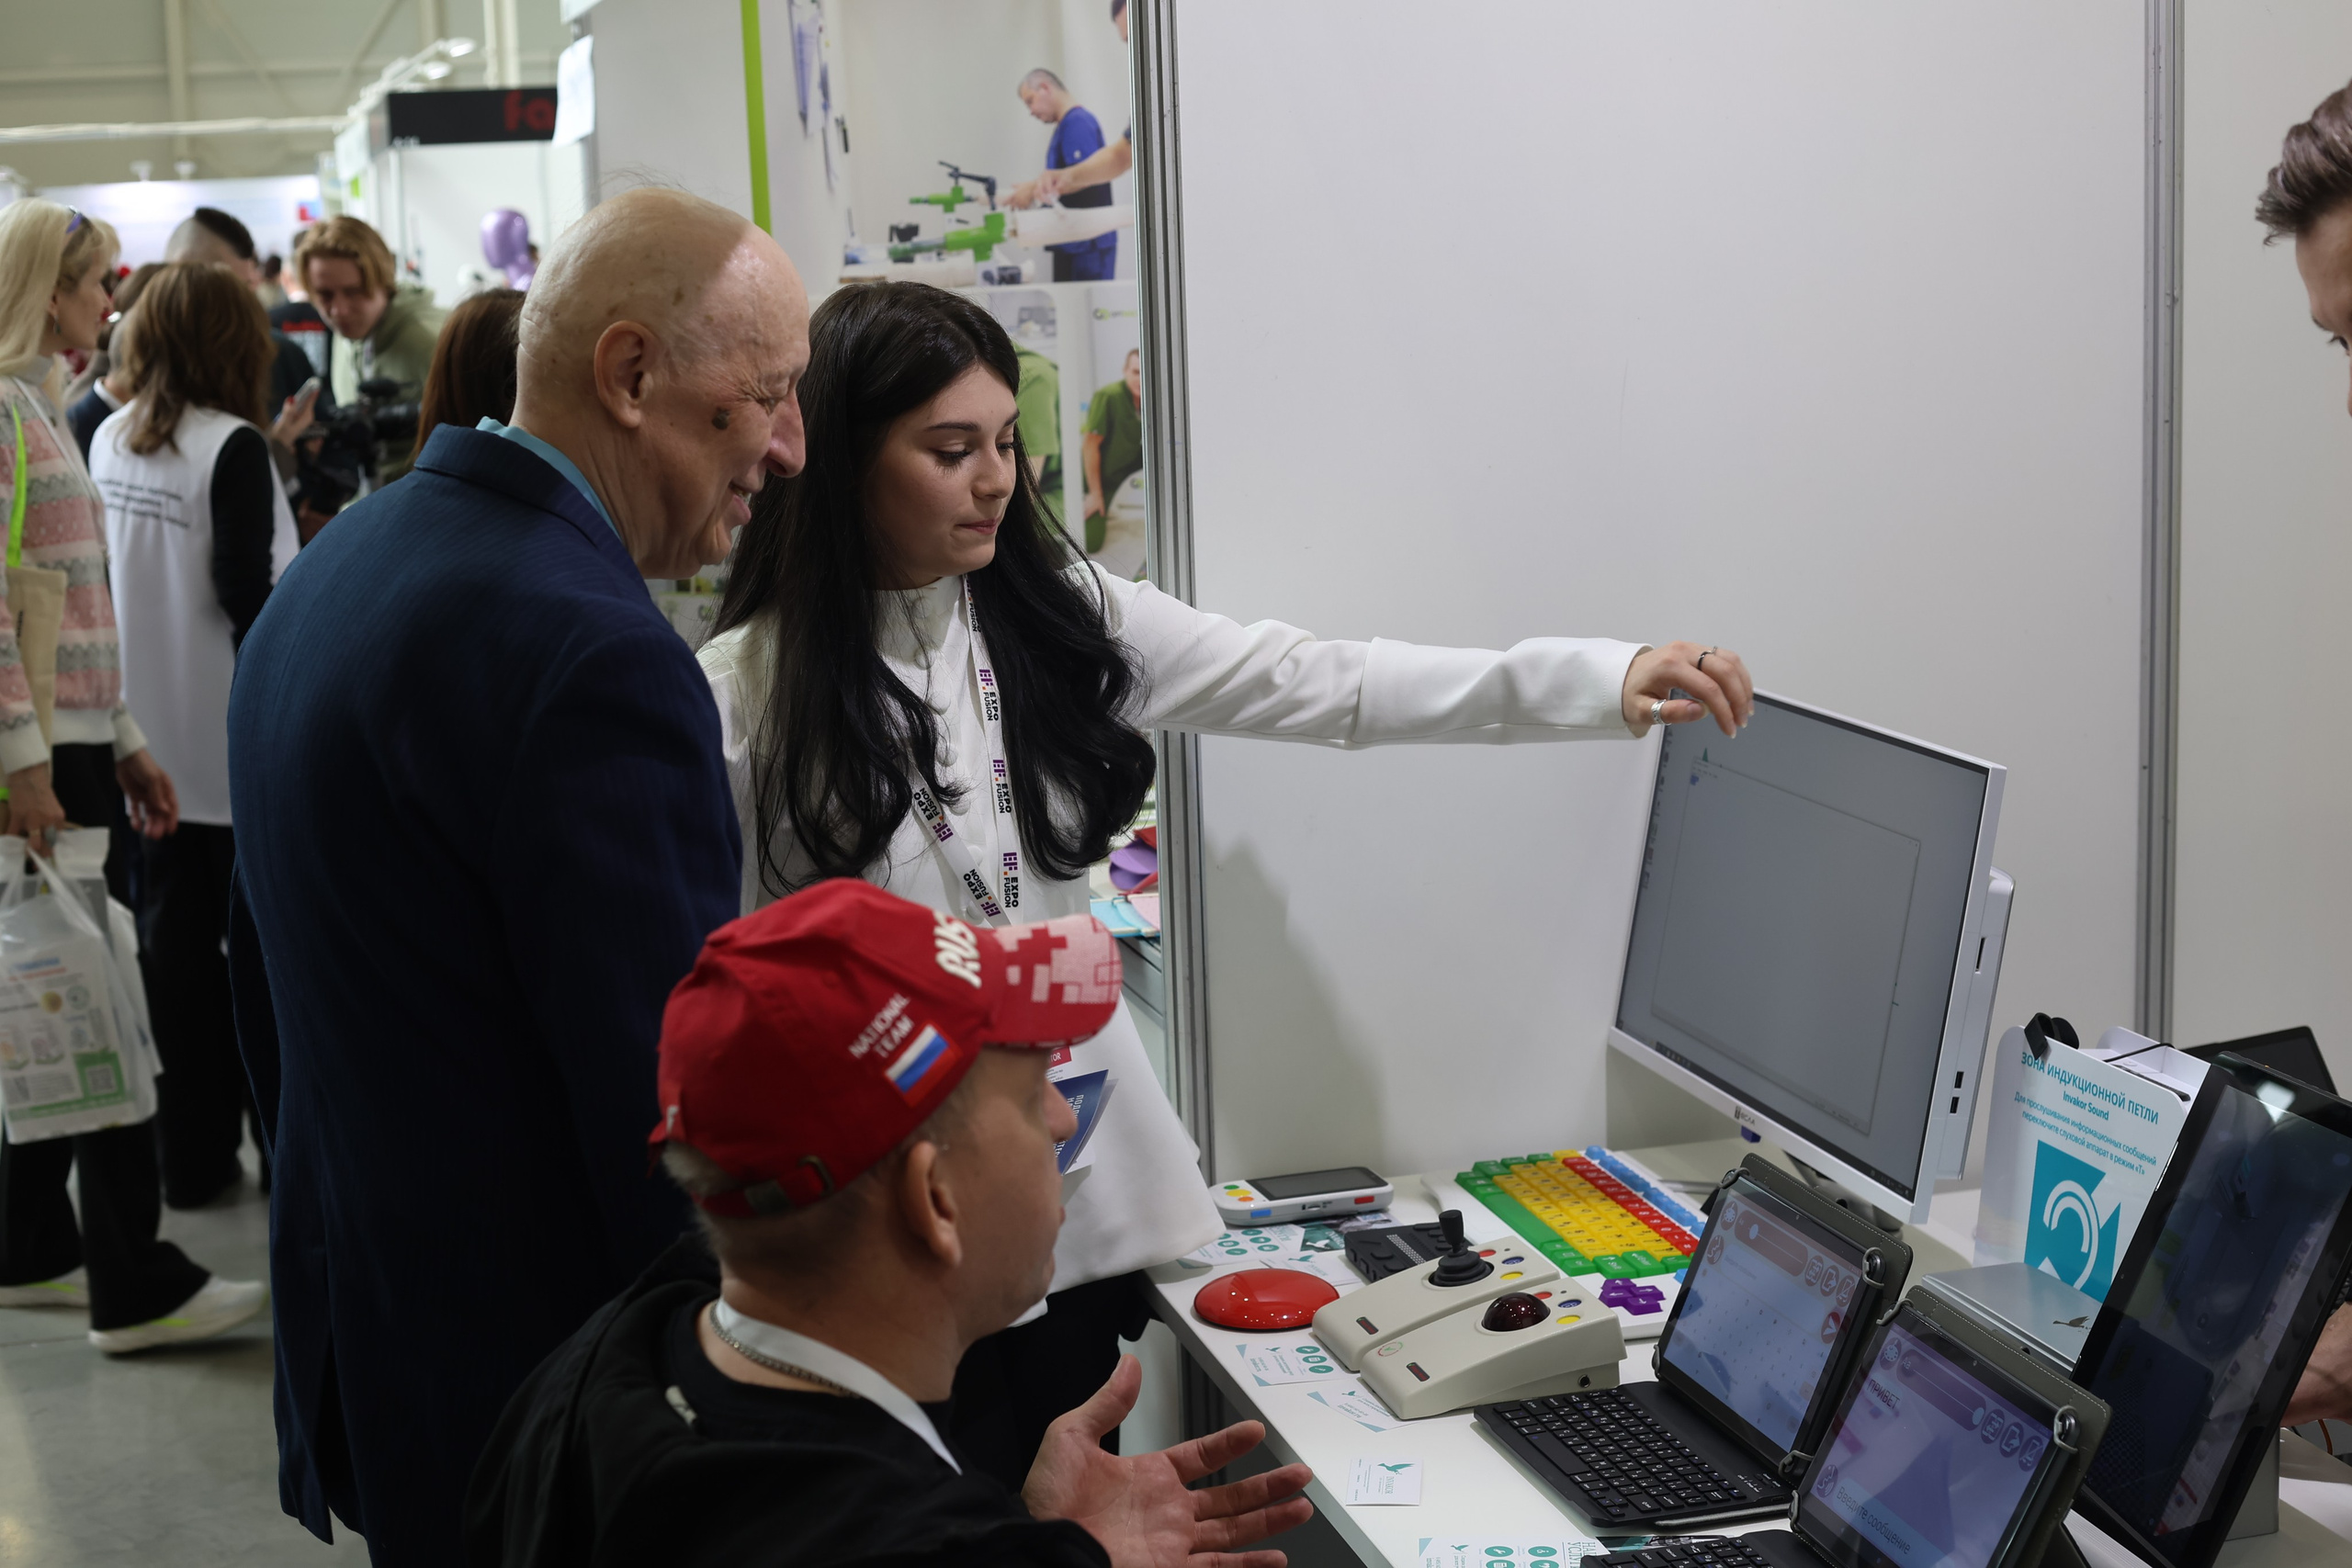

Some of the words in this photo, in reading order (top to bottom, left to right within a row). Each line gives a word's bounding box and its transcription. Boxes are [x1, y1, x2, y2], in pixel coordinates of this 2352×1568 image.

[983, 692, 993, 721] FUSION
[989, 691, 999, 721] EXPO
[913, 792, 934, 821] EXPO
[920, 787, 940, 817] FUSION
[996, 783, 1005, 813] FUSION
[1001, 783, 1012, 813] EXPO
[963, 873, 983, 900] EXPO
[969, 868, 989, 897] FUSION
[1003, 877, 1012, 908] FUSION
[1011, 876, 1019, 908] EXPO
[848, 992, 911, 1059] NATIONAL
[873, 1013, 915, 1059] TEAM
[2021, 1052, 2045, 1073] ЗОНА
[2047, 1063, 2126, 1110] ИНДУКЦИОННОЙ
[2127, 1100, 2159, 1125] ПЕТЛИ
[2063, 1090, 2087, 1111] Invakor
[2087, 1102, 2109, 1121] Sound
[2014, 1091, 2026, 1103] Для
[2026, 1098, 2071, 1124] прослушивания
[2070, 1119, 2122, 1150] информационных
[2122, 1144, 2157, 1166] сообщений
[2022, 1111, 2060, 1134] переключите
[2060, 1128, 2086, 1147] слуховой
[2086, 1141, 2109, 1158] аппарат
[2113, 1155, 2134, 1171] режим
[1868, 1378, 1900, 1410] ПРИВЕТ
[1837, 1485, 1869, 1520] Введите
[1867, 1514, 1911, 1555] сообщение
